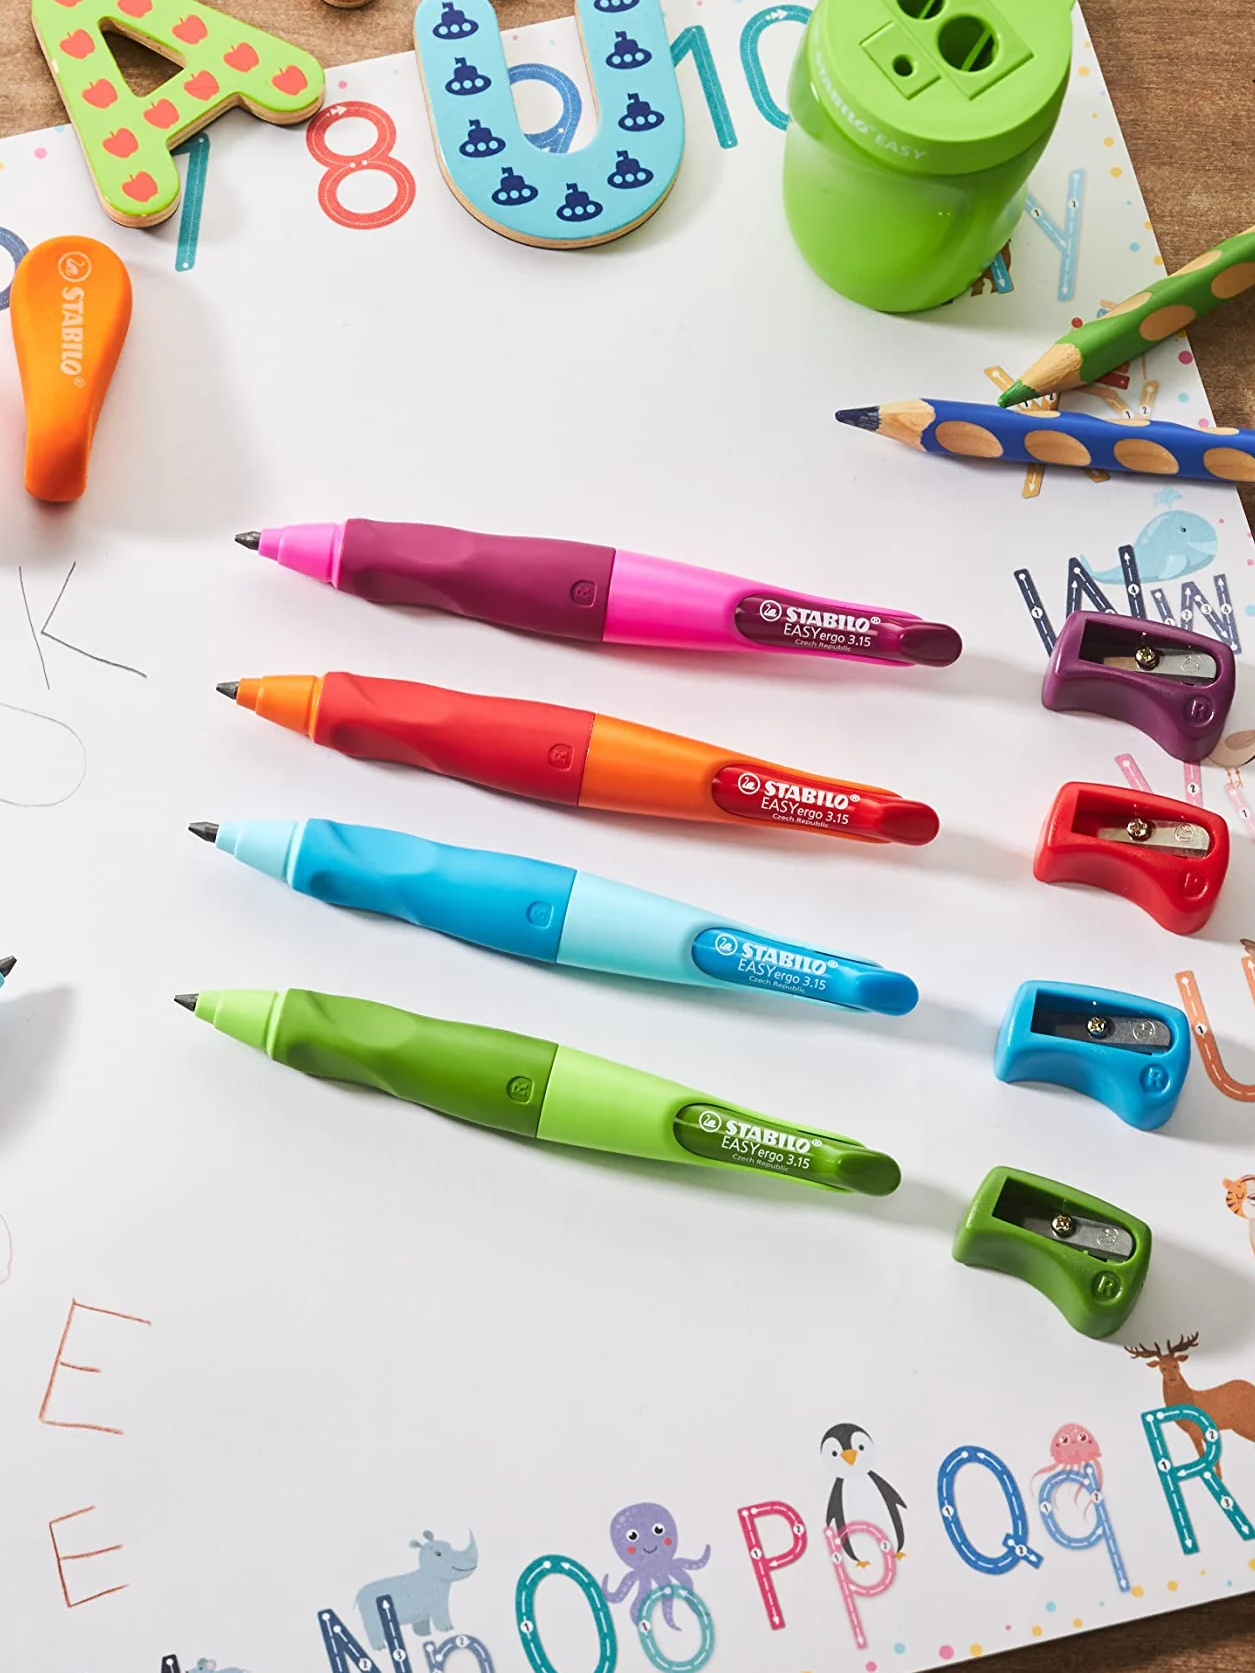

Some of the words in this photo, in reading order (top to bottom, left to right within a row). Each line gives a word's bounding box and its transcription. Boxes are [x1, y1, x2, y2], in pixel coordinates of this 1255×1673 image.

[305, 100, 416, 230] 8
[59, 286, 85, 376] STABILO
[19, 562, 148, 690] K
[783, 622, 846, 643] EASYergo
[848, 635, 872, 647] 3.15
[786, 606, 870, 633] STABILO
[761, 797, 823, 820] EASYergo
[826, 812, 849, 824] 3.15
[764, 781, 849, 810] STABILO
[738, 958, 800, 985] EASYergo
[803, 976, 826, 990] 3.15
[742, 943, 826, 975] STABILO
[721, 1136, 784, 1163] EASYergo
[786, 1155, 810, 1169] 3.15
[726, 1120, 811, 1154] STABILO
[39, 1298, 152, 1436] E
[1140, 1404, 1255, 1555] R
[48, 1505, 129, 1608] E
